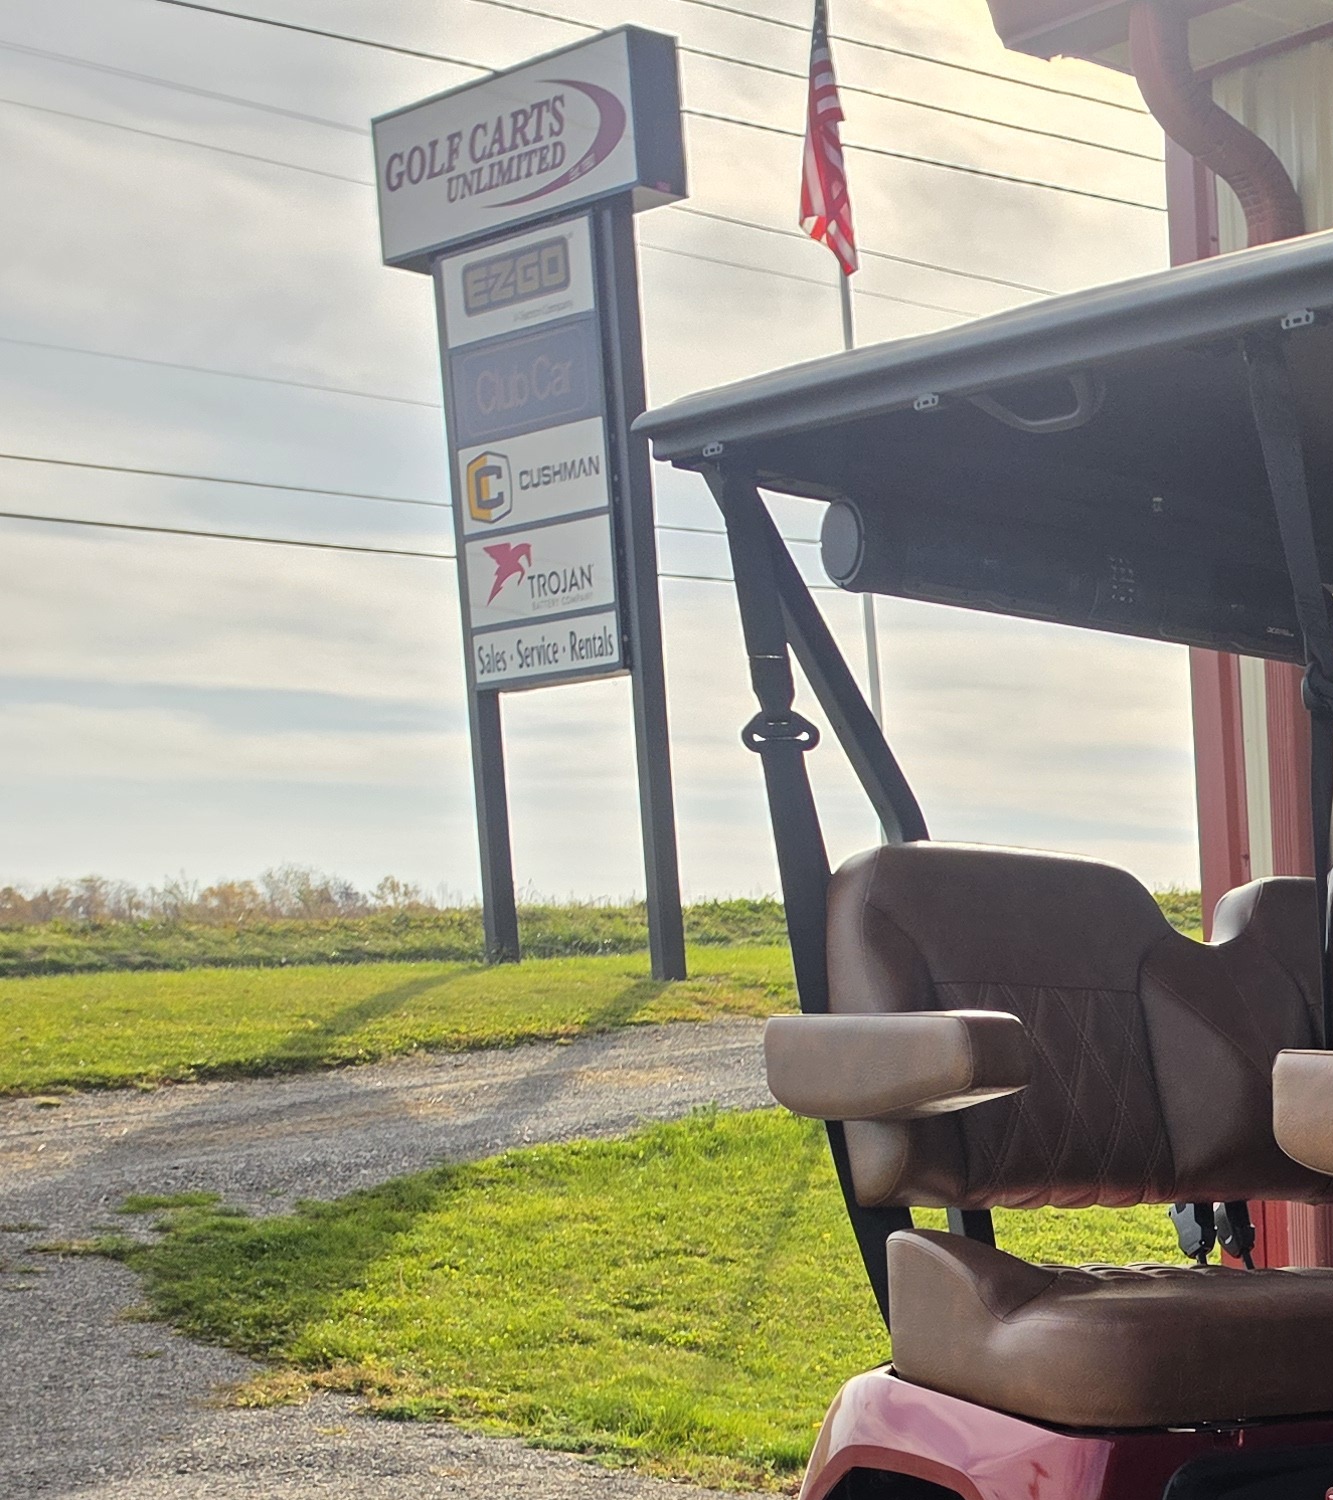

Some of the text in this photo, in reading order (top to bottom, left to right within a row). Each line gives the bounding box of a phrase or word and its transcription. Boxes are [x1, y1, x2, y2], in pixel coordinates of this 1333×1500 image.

[386, 94, 566, 192] GOLF CARTS
[446, 141, 566, 203] UNLIMITED
[518, 454, 601, 491] CUSHMAN
[526, 564, 595, 599] TROJAN
[477, 624, 615, 676] Sales Service Rentals
